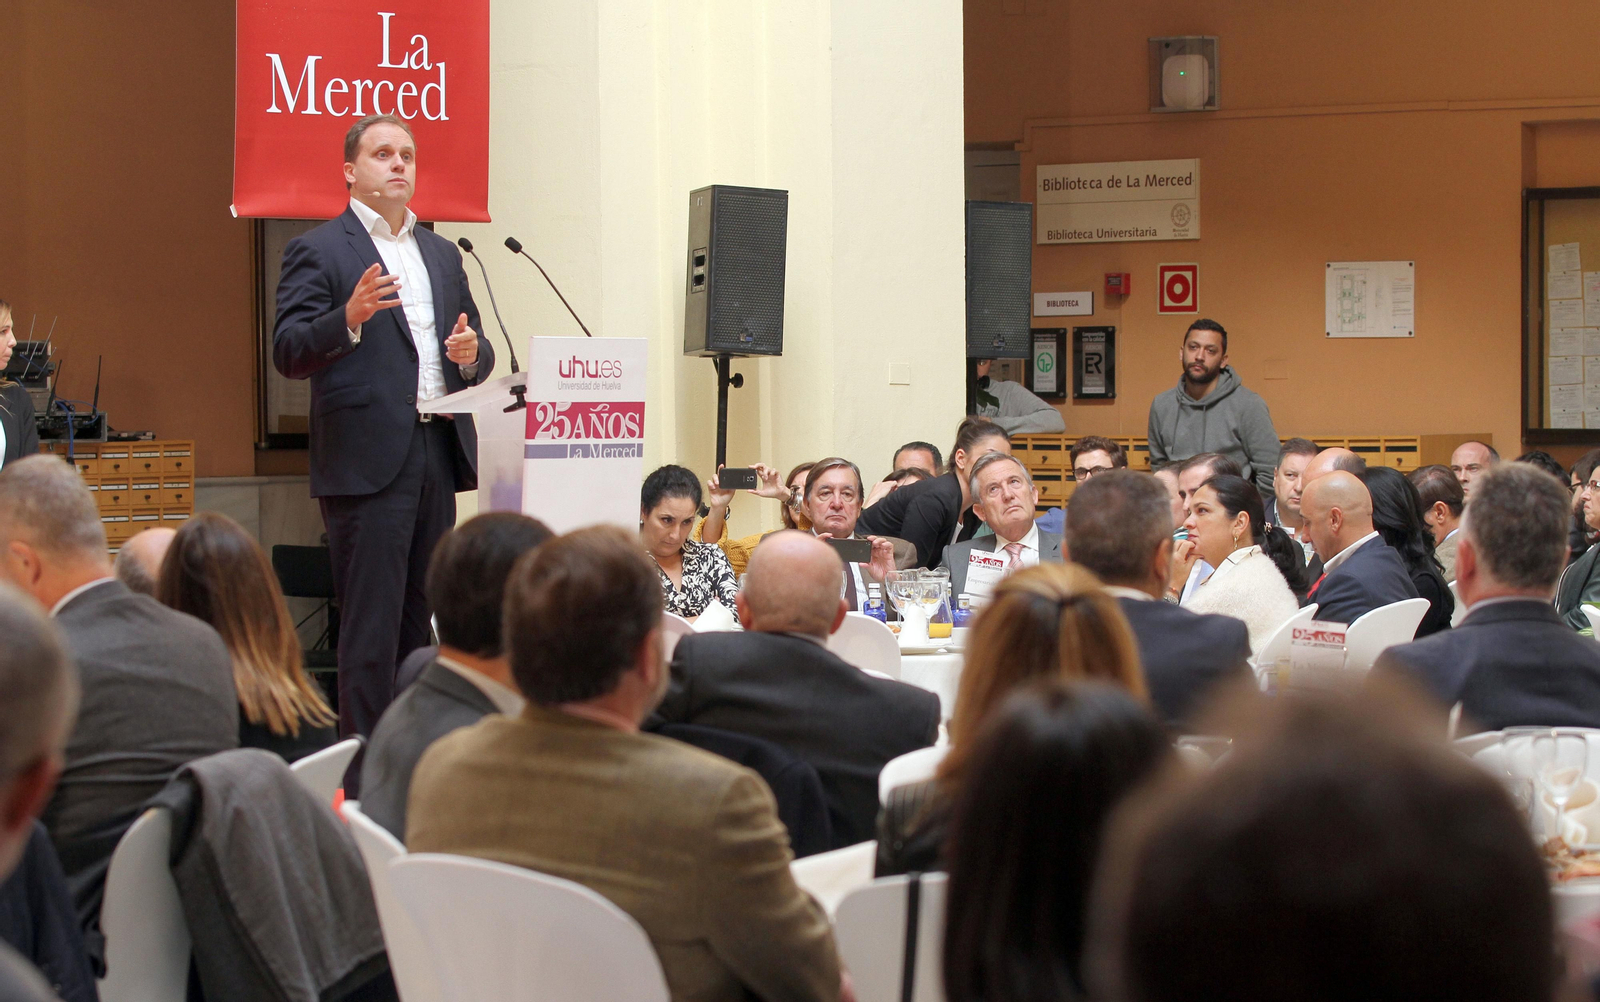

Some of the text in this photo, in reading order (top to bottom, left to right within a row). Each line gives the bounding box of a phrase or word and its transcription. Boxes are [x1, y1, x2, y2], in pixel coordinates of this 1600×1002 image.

[377, 12, 433, 71] La
[265, 53, 450, 121] Merced
[1043, 172, 1193, 192] Biblioteca de La Merced
[1047, 228, 1094, 241] Biblioteca
[1096, 226, 1158, 239] Universitaria
[1046, 299, 1079, 308] BIBLIOTECA
[558, 355, 623, 379] uhu.es
[557, 381, 622, 391] Universidad de Huelva
[567, 443, 638, 459] La Merced
